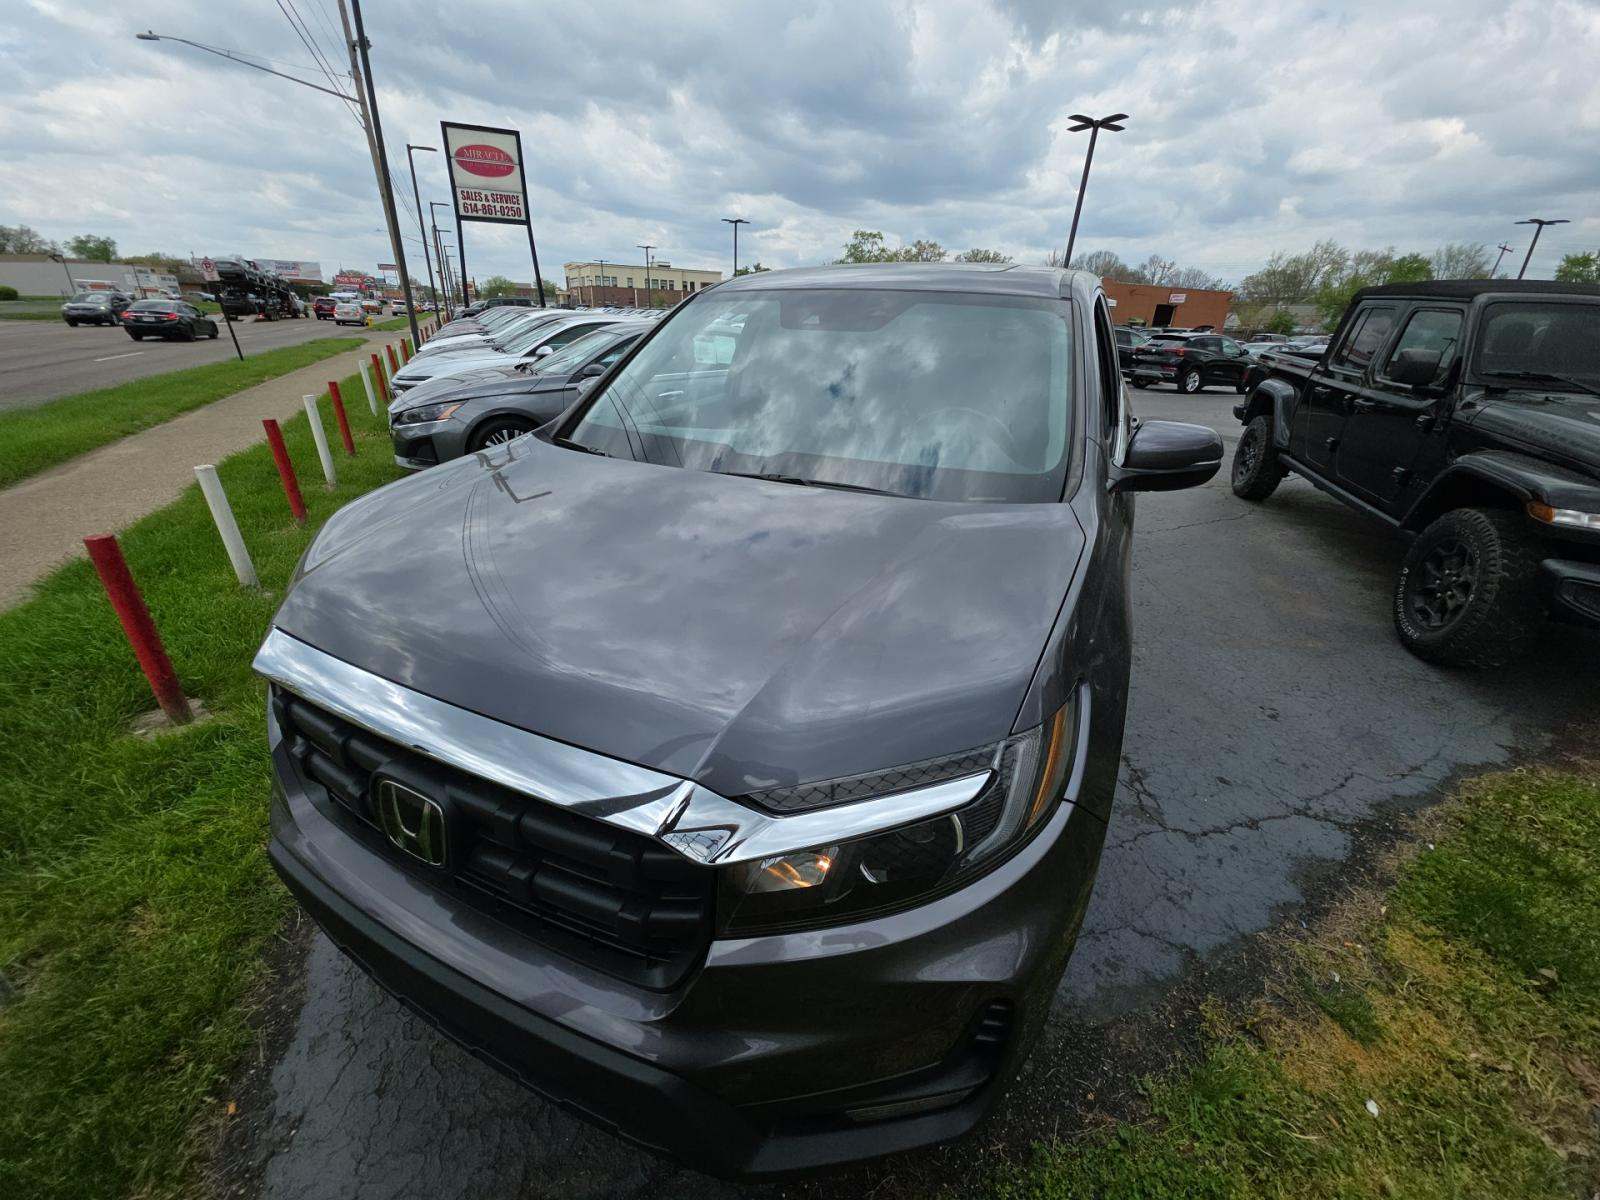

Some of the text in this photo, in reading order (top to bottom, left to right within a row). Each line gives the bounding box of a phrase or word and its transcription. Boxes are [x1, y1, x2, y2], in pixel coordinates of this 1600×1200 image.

[460, 190, 520, 205] SALES & SERVICE
[463, 202, 521, 217] 614-861-0250
